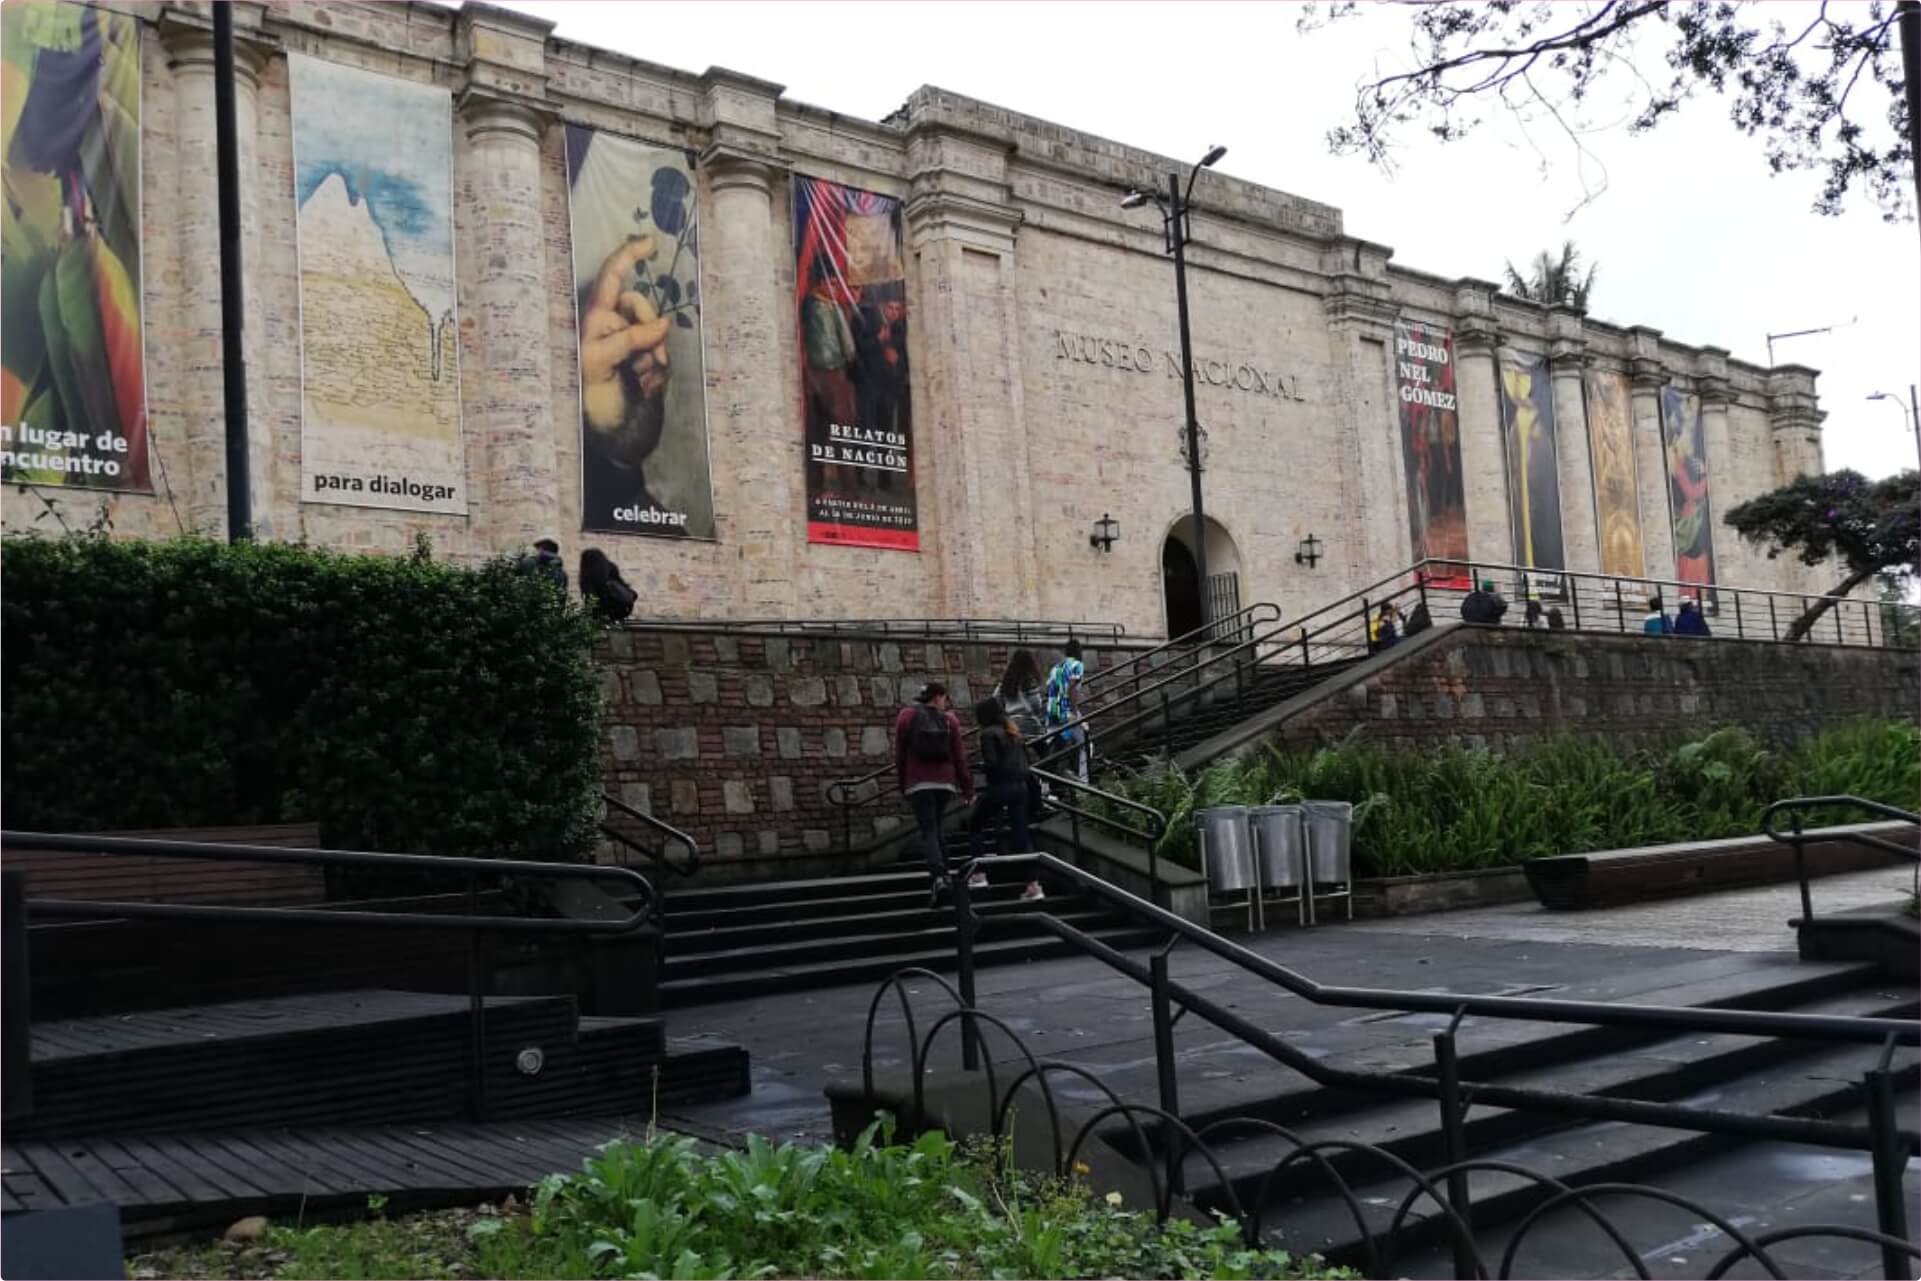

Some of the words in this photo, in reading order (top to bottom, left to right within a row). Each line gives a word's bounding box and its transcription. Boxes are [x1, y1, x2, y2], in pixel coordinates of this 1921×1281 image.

[1055, 329, 1153, 373] MUSEO
[1397, 337, 1449, 365] PEDRO
[1400, 361, 1431, 383] NEL
[1401, 380, 1456, 411] GÓMEZ
[19, 421, 91, 450] lugar
[95, 430, 129, 453] de
[829, 424, 906, 445] RELATOS
[0, 450, 121, 477] ncuentro
[811, 443, 836, 459] DE
[841, 447, 908, 468] NACIÓN
[314, 474, 364, 492] para
[368, 475, 456, 501] dialogar
[612, 504, 688, 526] celebrar
